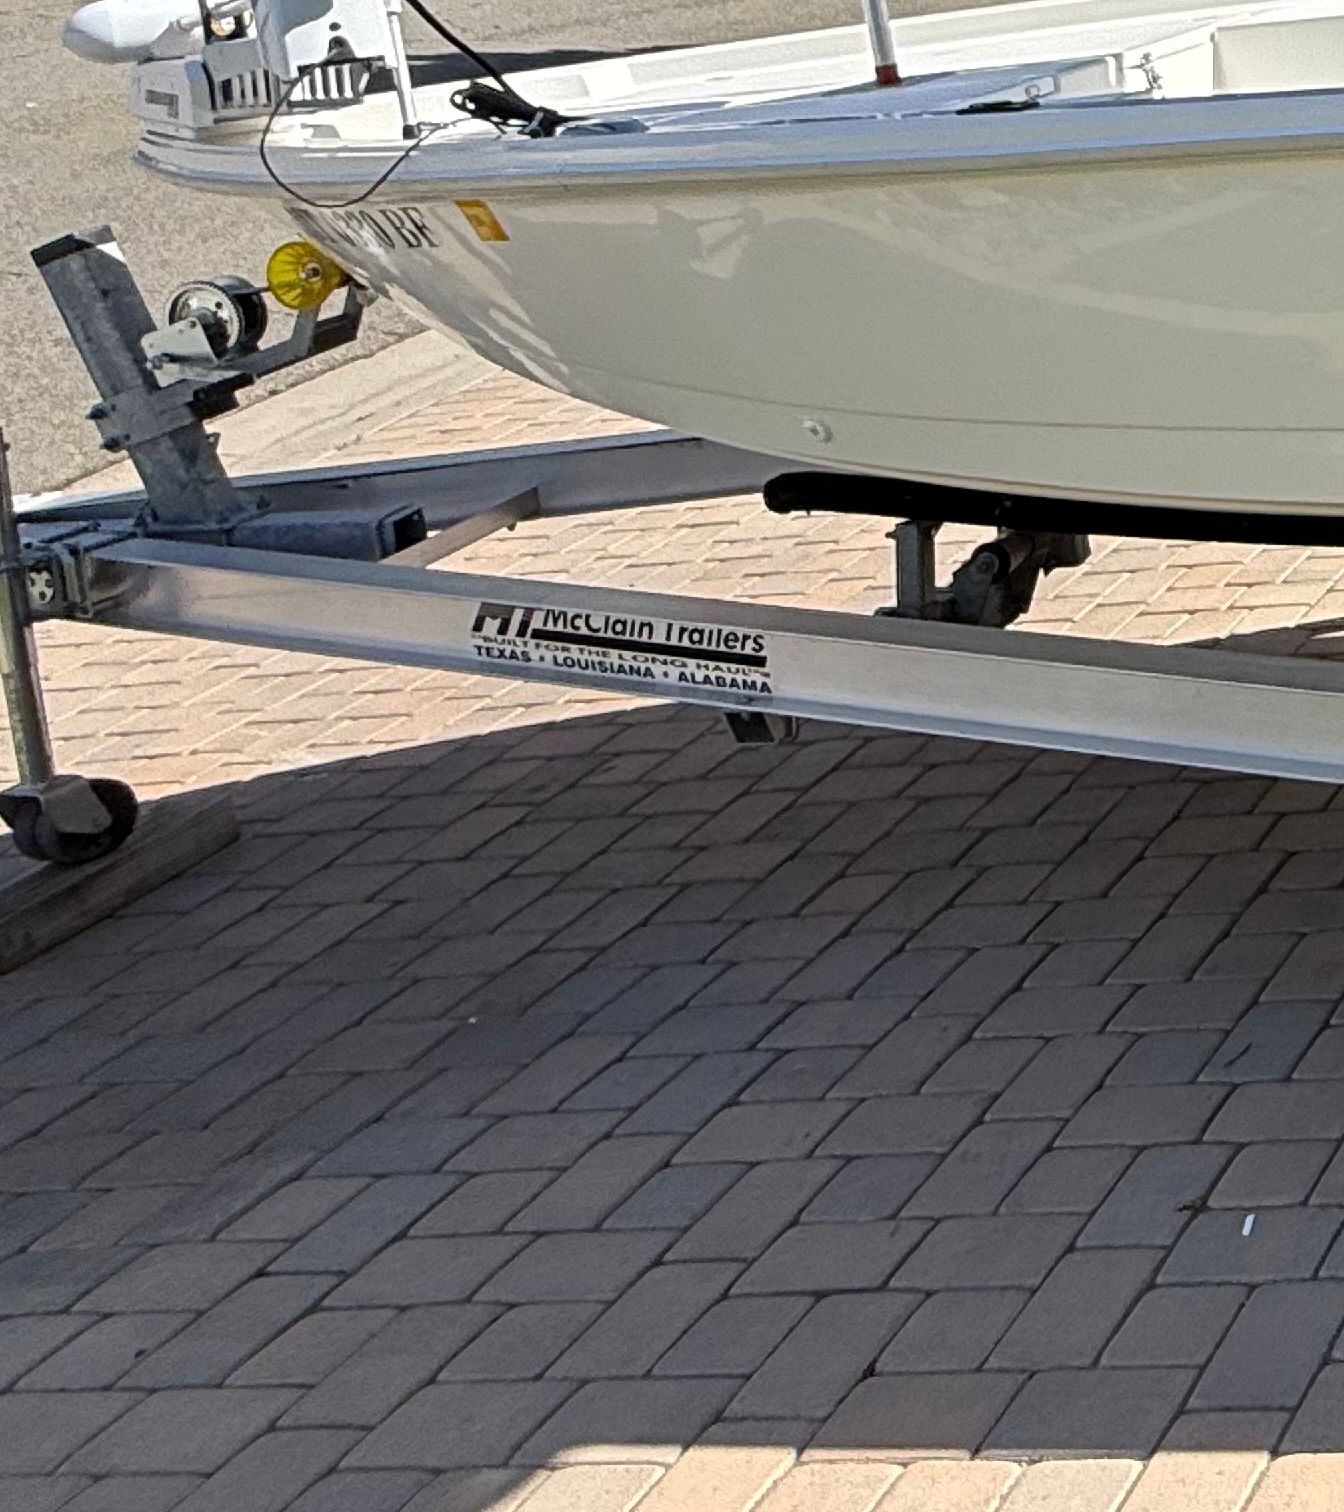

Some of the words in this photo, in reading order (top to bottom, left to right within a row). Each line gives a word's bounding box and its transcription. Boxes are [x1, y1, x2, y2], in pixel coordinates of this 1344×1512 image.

[542, 608, 655, 640] McClain
[664, 622, 765, 654] Trailers
[473, 644, 532, 663] TEXAS
[552, 654, 657, 680] LOUISIANA
[678, 670, 773, 694] ALABAMA
